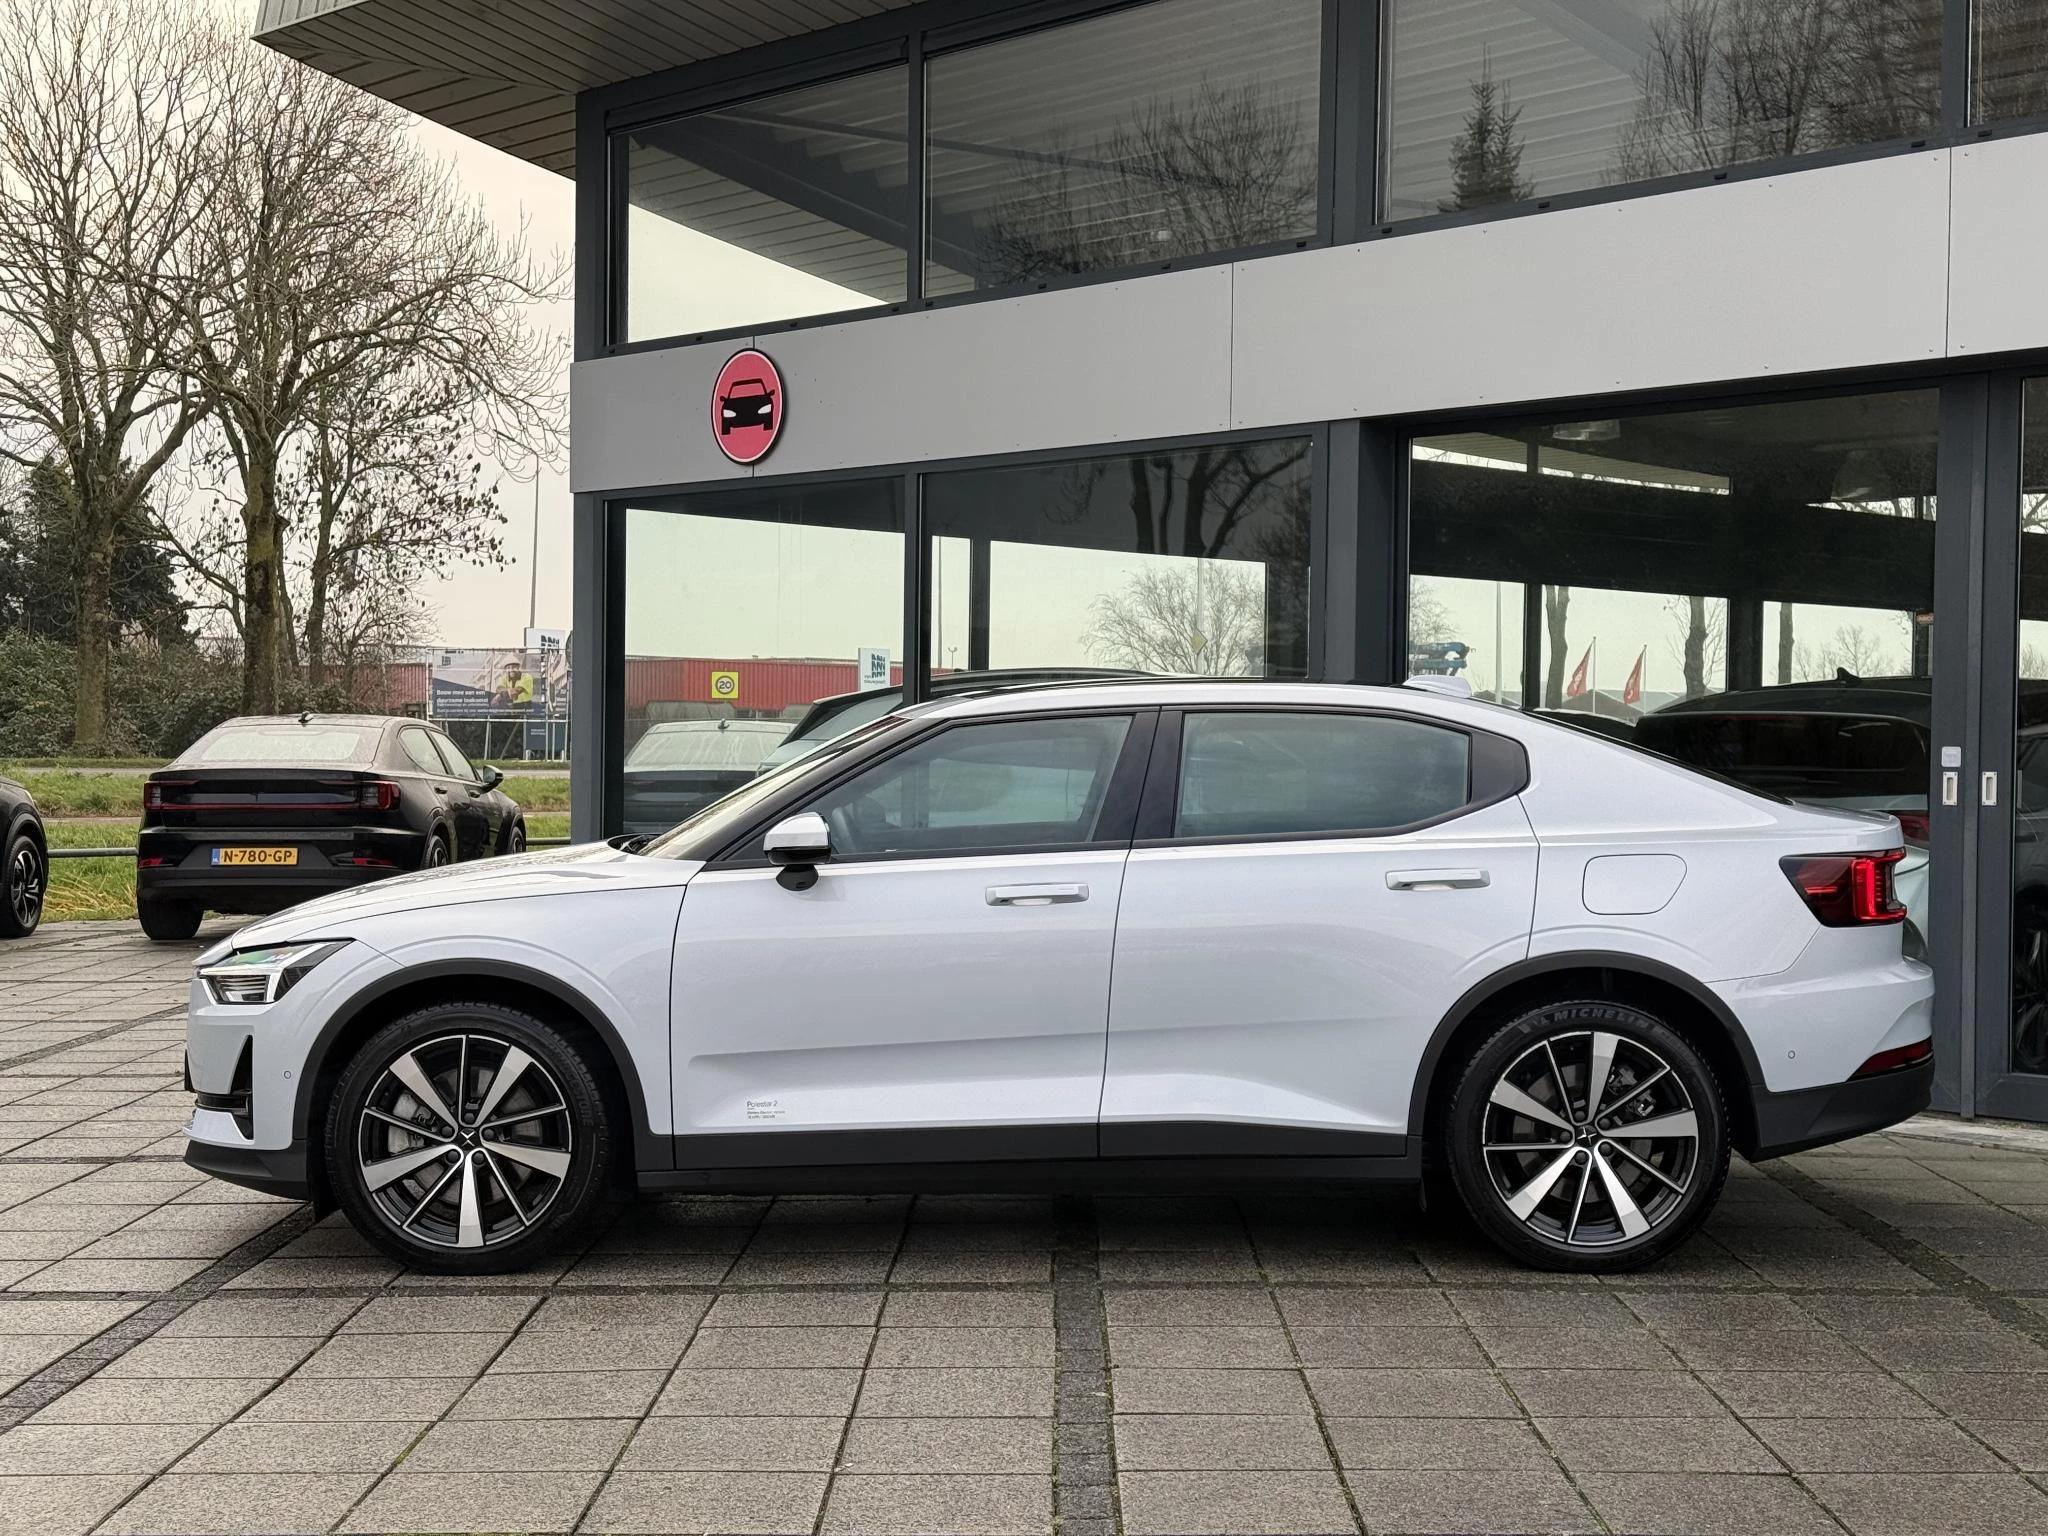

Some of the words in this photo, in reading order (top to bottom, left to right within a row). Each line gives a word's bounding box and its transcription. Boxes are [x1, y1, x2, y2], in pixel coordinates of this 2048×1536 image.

[719, 681, 732, 689] 20
[224, 850, 292, 862] N-780-GP
[1554, 1008, 1649, 1028] MICHELIN
